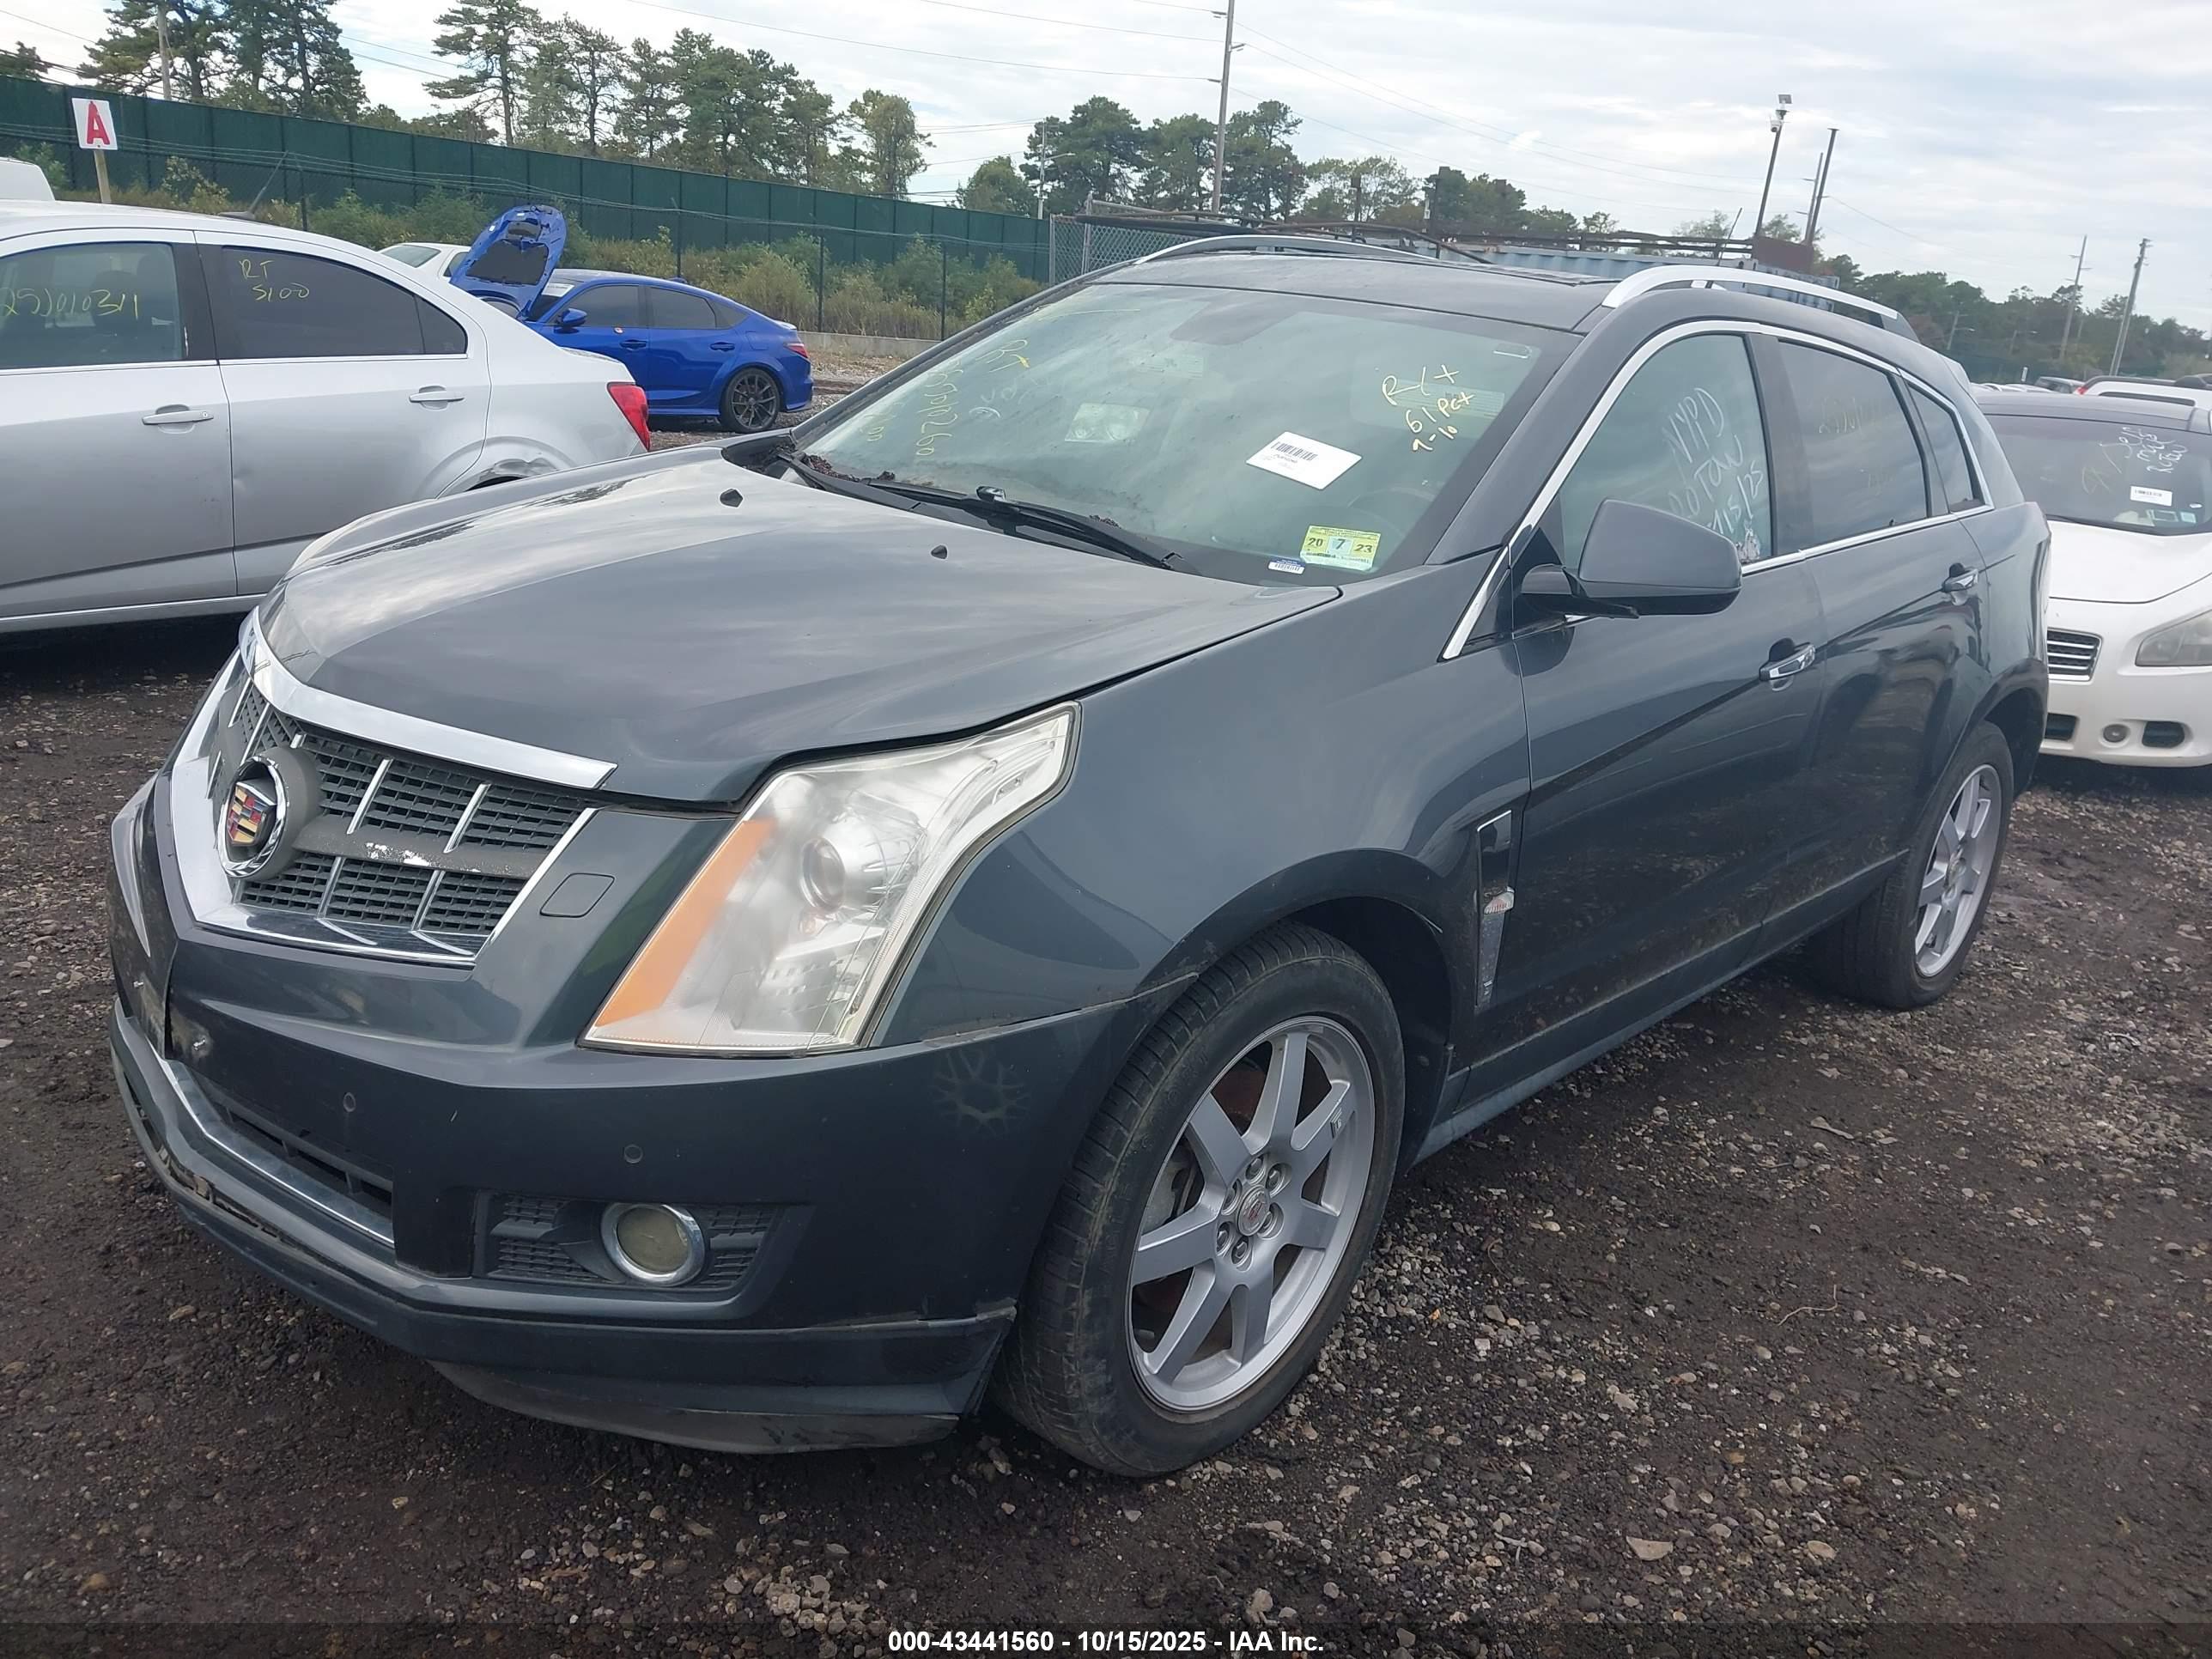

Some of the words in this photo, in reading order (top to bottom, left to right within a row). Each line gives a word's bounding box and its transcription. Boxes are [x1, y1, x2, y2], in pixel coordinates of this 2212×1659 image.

[87, 100, 110, 145] A
[1307, 538, 1324, 547] 20
[1335, 538, 1346, 550] 7
[1354, 544, 1373, 554] 23
